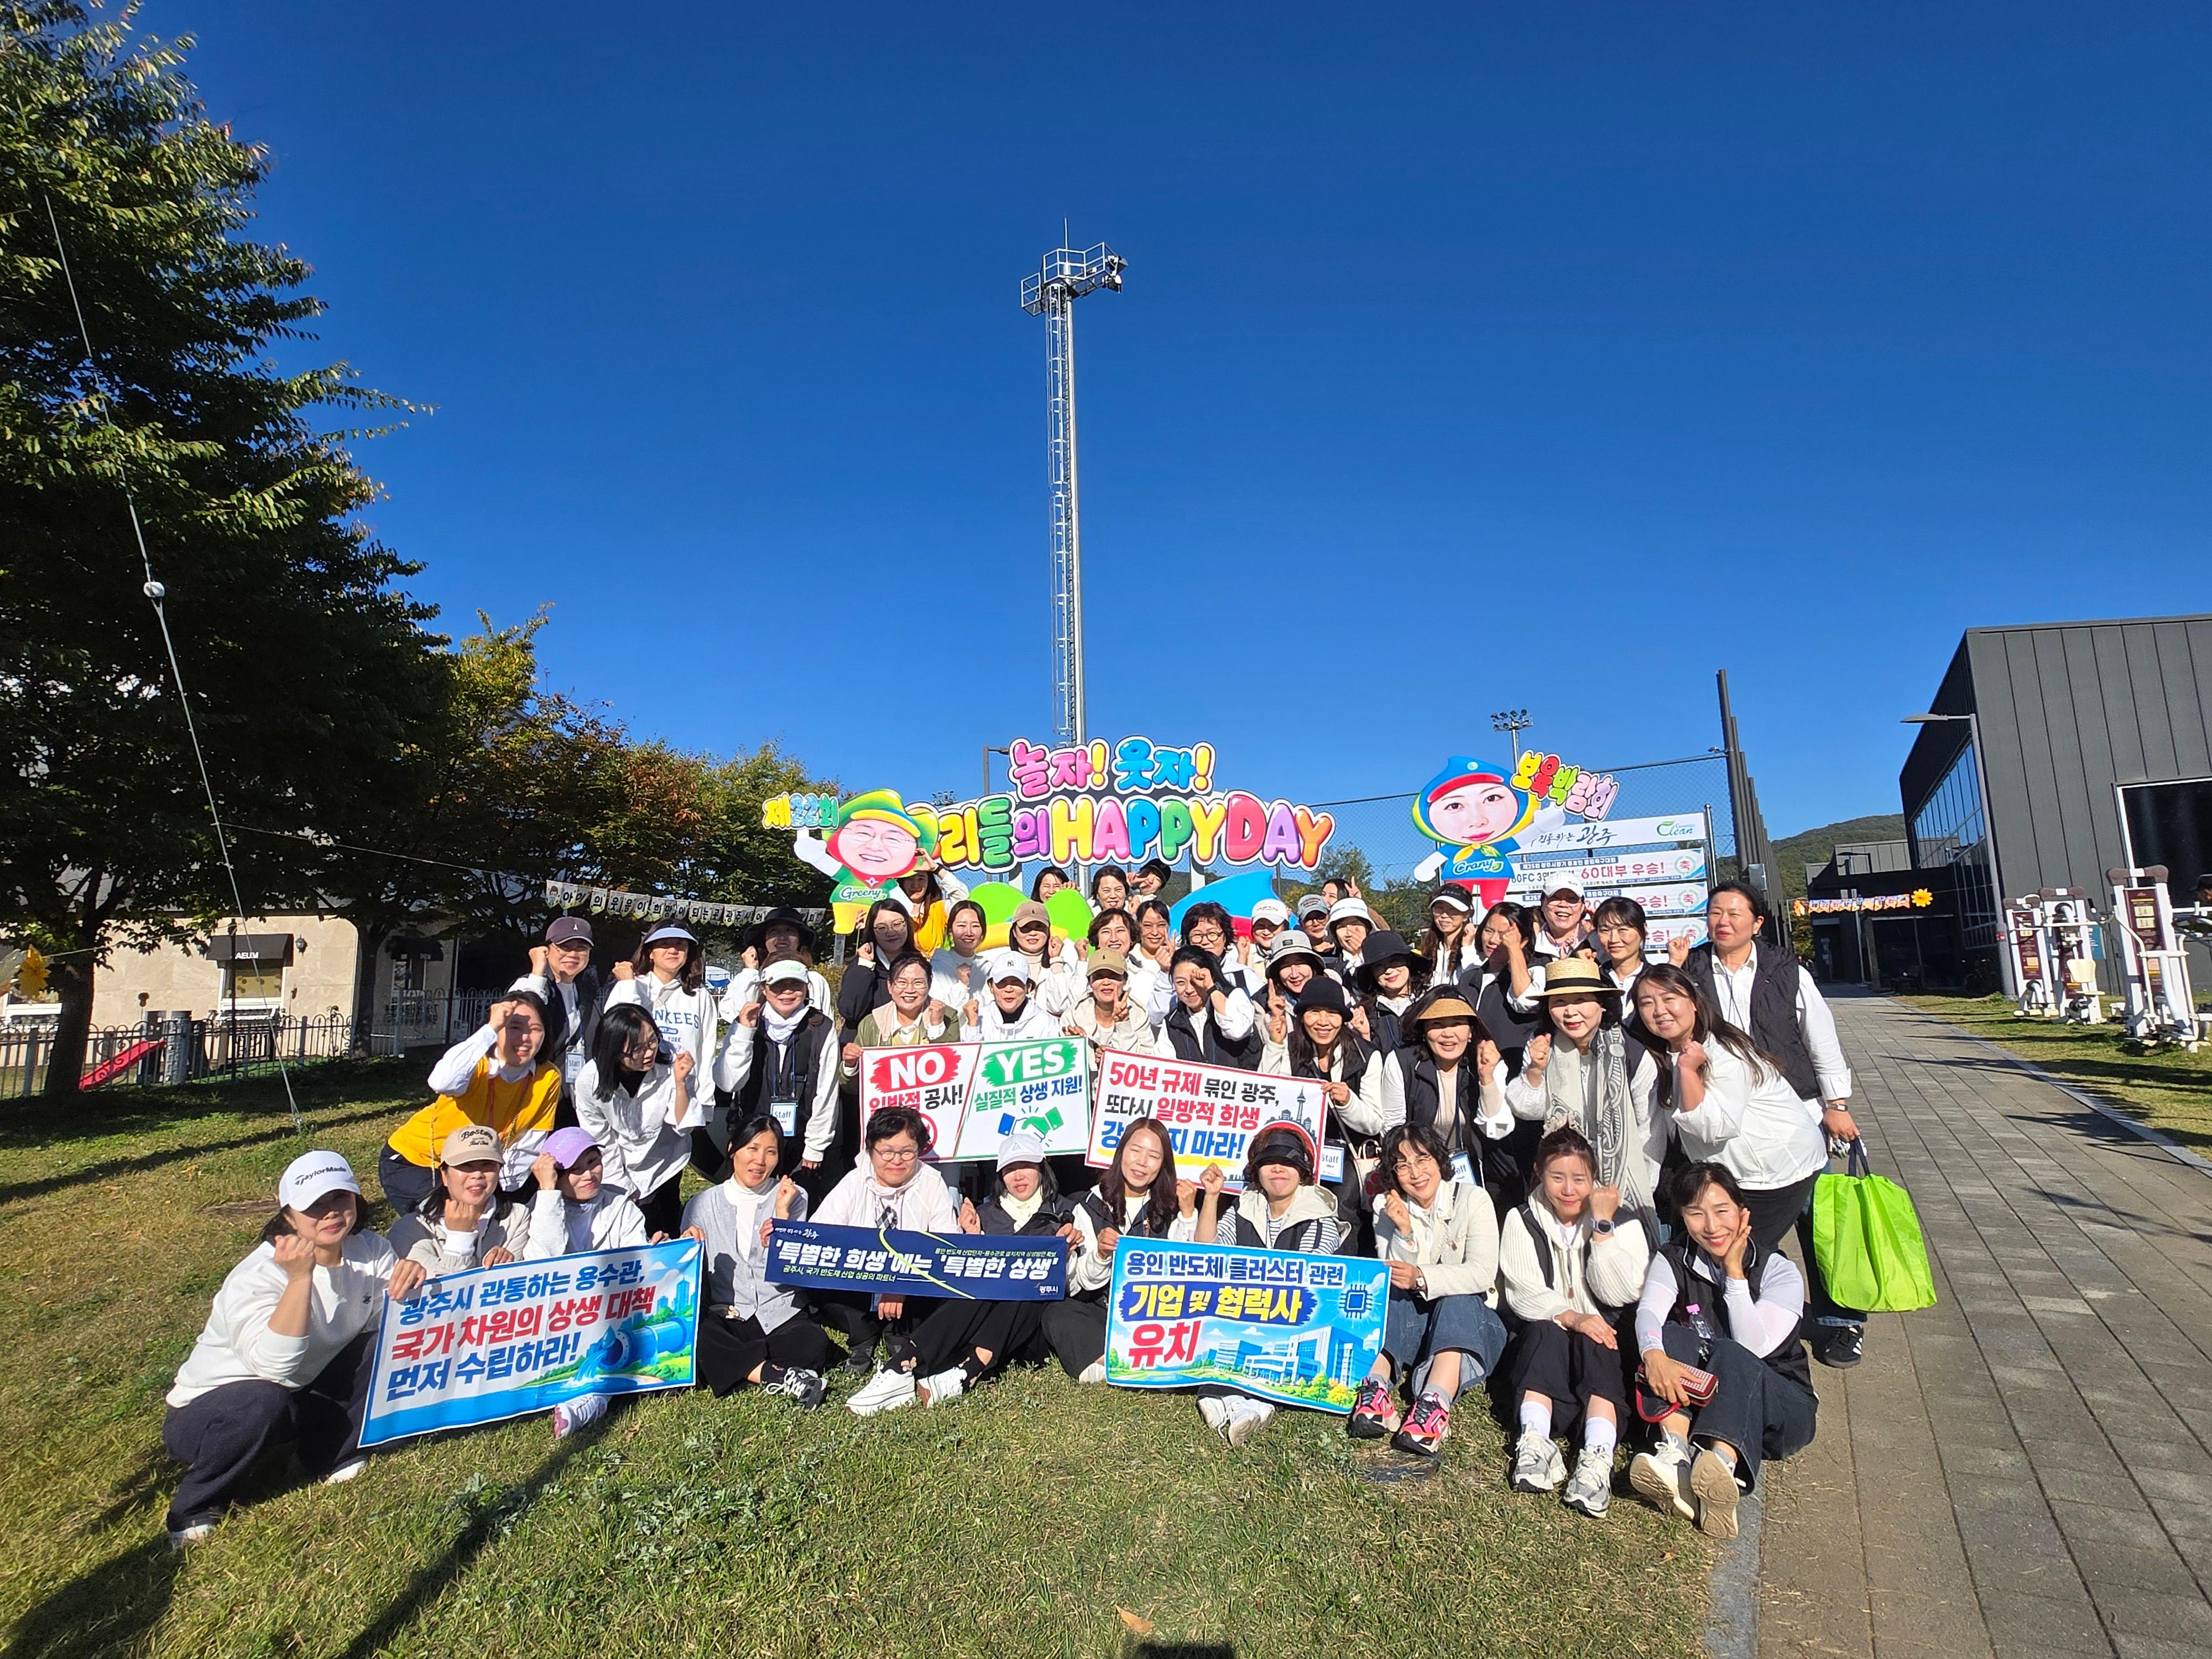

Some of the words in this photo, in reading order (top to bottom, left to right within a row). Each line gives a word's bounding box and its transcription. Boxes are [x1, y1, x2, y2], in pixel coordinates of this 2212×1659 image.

[1013, 742, 1107, 798] 놀자!
[1117, 738, 1212, 794] 웃자!
[1513, 751, 1618, 821] 보육박람회
[764, 794, 837, 827] 제22회
[932, 797, 1050, 867] 리들의
[1576, 825, 1618, 846] 광주
[1454, 860, 1493, 873] Crany
[1581, 864, 1627, 879] 60대부
[1632, 862, 1665, 876] 우승!
[1679, 860, 1691, 870] 축
[611, 896, 645, 912] 웃음이
[841, 887, 881, 900] Greeny
[1683, 894, 1694, 904] 축
[1647, 930, 1671, 943] 승!
[655, 1009, 700, 1029] NKEES
[889, 1051, 946, 1089] NO
[995, 1044, 1066, 1082] YES
[925, 1084, 963, 1110] 공사!
[974, 1087, 1016, 1112] 실질적
[1020, 1081, 1048, 1103] 상생
[1051, 1075, 1082, 1097] 지원!
[1109, 1061, 1159, 1091] 50년
[1161, 1070, 1202, 1097] 규제
[1204, 1078, 1237, 1099] 묶인
[1241, 1083, 1279, 1107] 광주,
[1104, 1094, 1153, 1118] 또다시
[1156, 1097, 1215, 1126] 일방적
[1218, 1104, 1260, 1130] 희생
[461, 1129, 493, 1141] Boston
[1101, 1120, 1189, 1155] 강지
[1190, 1130, 1246, 1159] 마라!
[295, 1166, 347, 1186] TaylorMade
[783, 1264, 804, 1275] 광주시,
[806, 1266, 820, 1276] 국가
[820, 1268, 841, 1277] 반도체
[841, 1270, 854, 1279] 산업
[855, 1271, 875, 1280] 성공의
[875, 1273, 896, 1282] 파트너
[1127, 1253, 1162, 1276] 용인
[1169, 1254, 1224, 1279] 반도체
[1229, 1258, 1305, 1283] 클러스터
[1309, 1264, 1345, 1286] 관련
[399, 1285, 474, 1326] 광주시
[479, 1270, 570, 1307] 관통하는
[576, 1260, 645, 1292] 용수관,
[1128, 1285, 1186, 1318] 기업
[1188, 1290, 1212, 1314] 및
[1214, 1285, 1302, 1323] 협력사
[391, 1324, 456, 1361] 국가
[457, 1304, 543, 1346] 차원의
[547, 1293, 601, 1327] 상생
[605, 1286, 656, 1321] 대책
[1128, 1320, 1202, 1369] 유치
[387, 1358, 450, 1402] 먼저
[454, 1332, 582, 1384] 수립하라!
